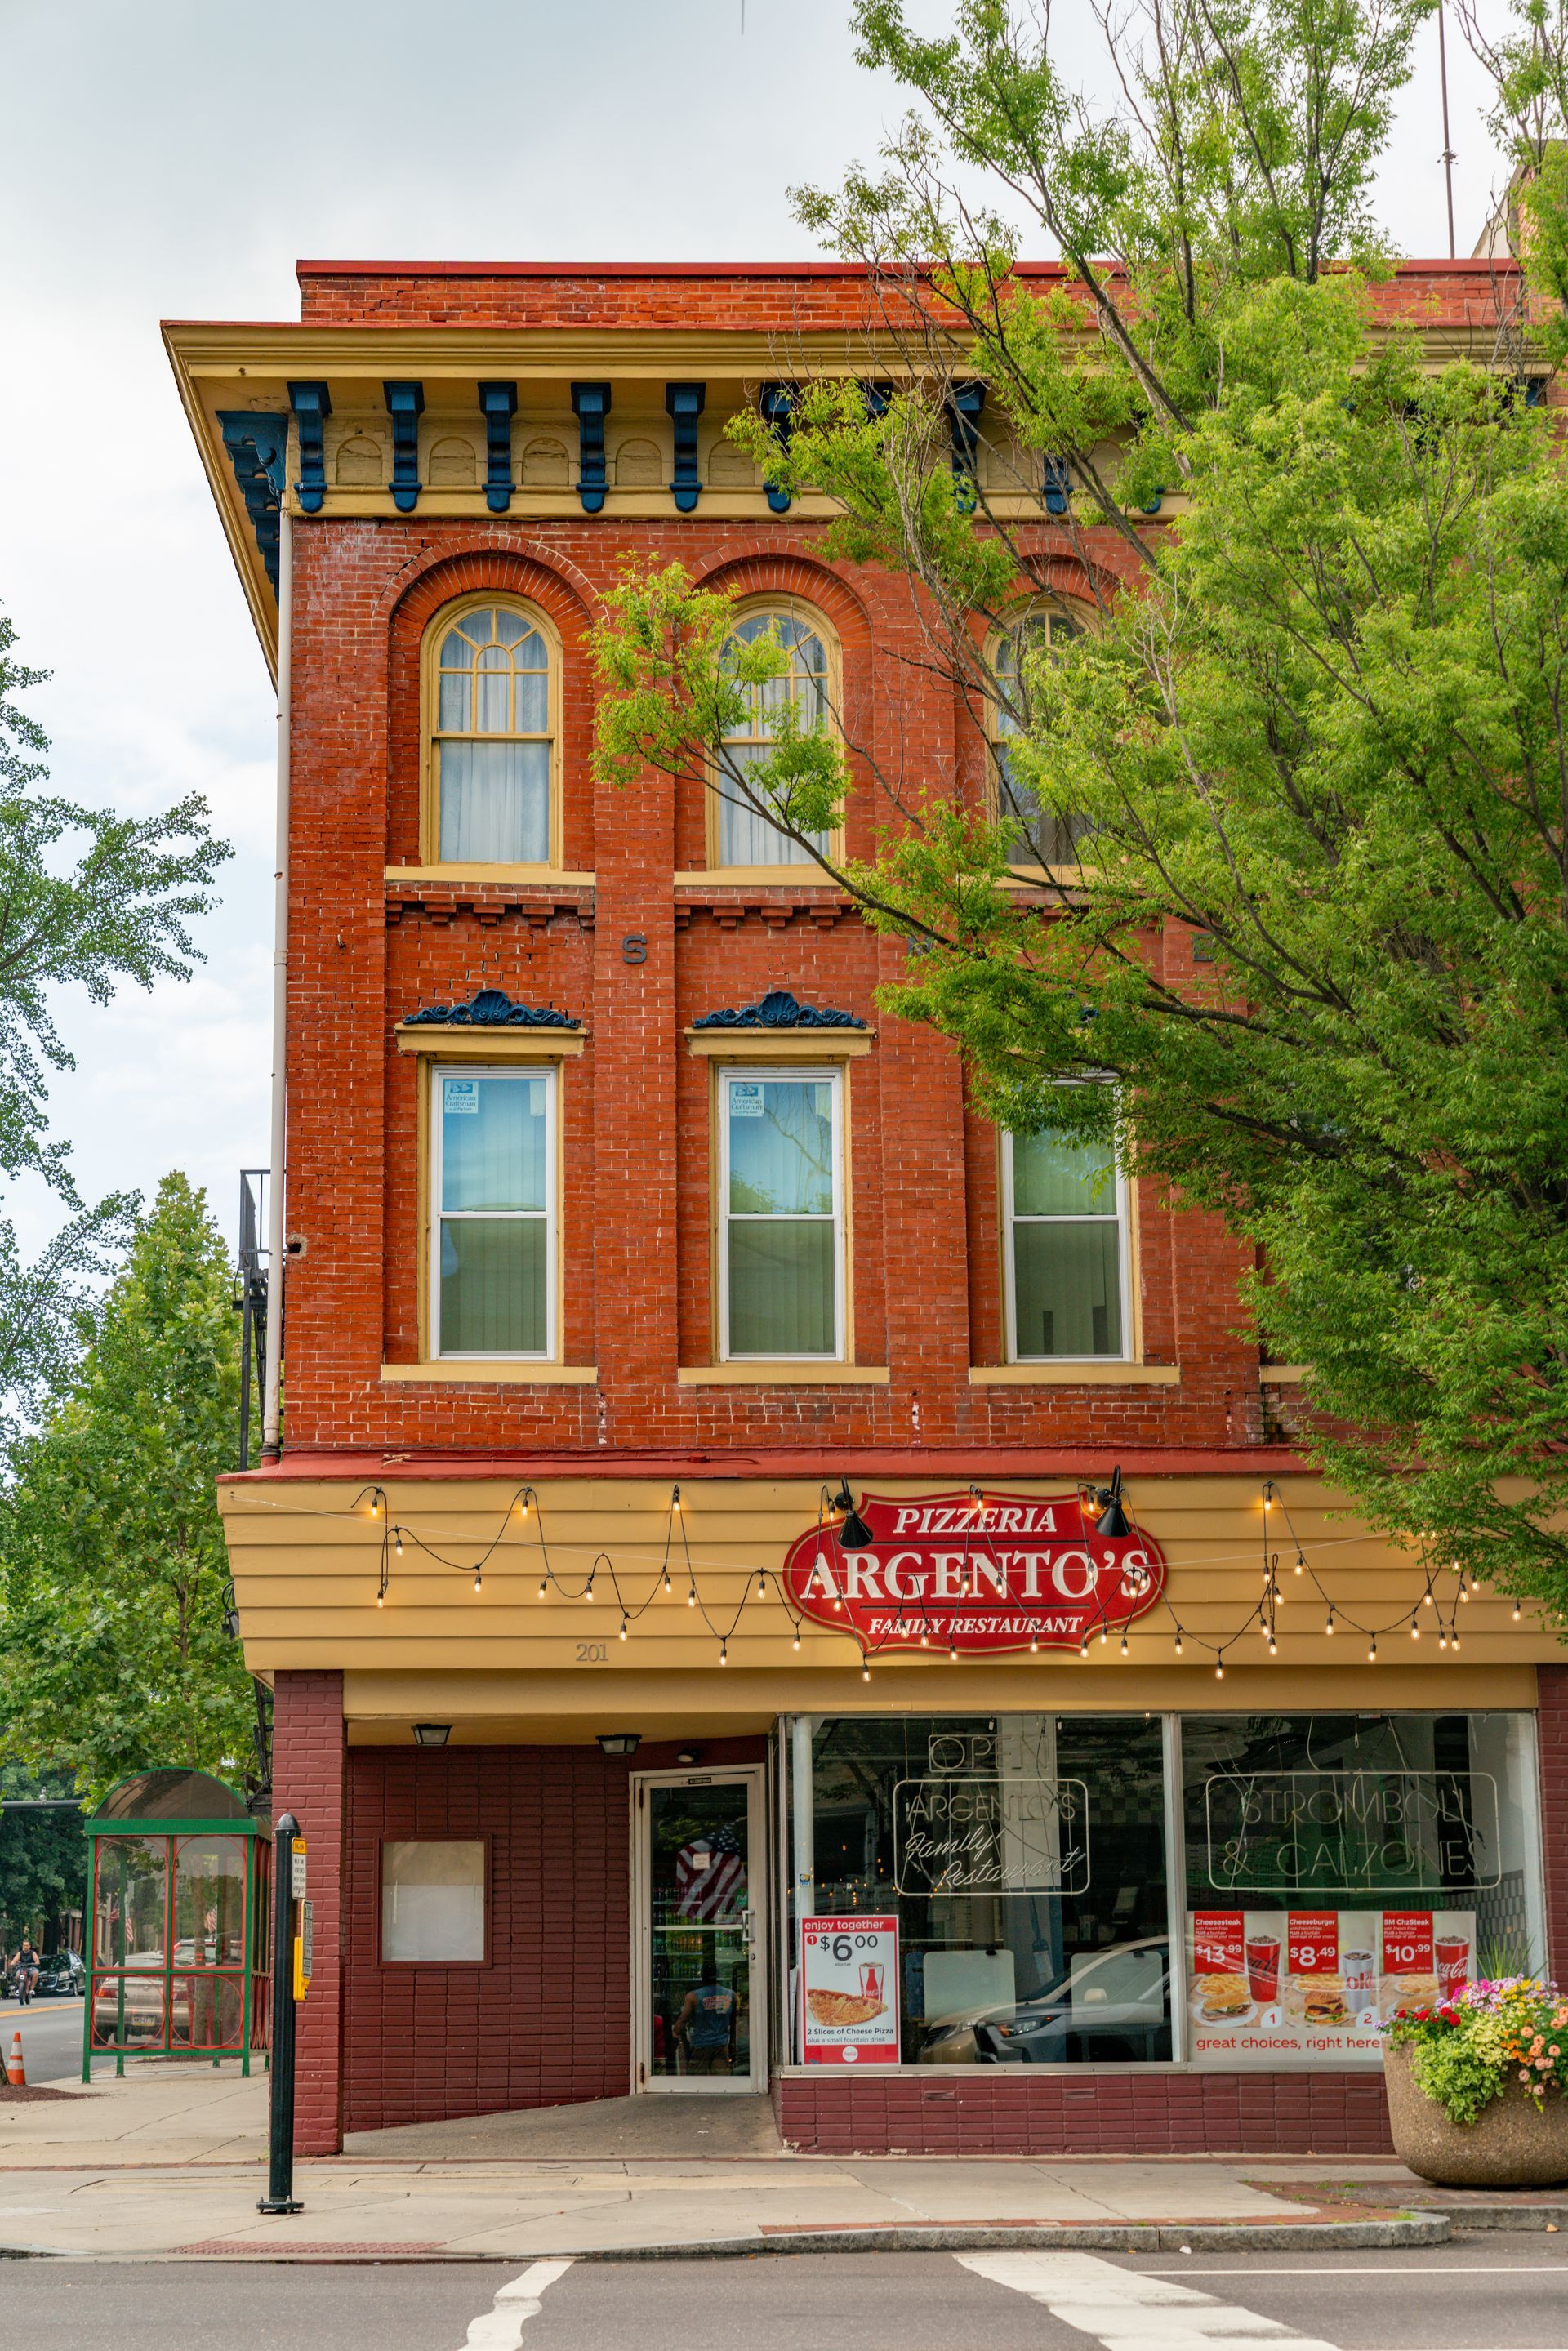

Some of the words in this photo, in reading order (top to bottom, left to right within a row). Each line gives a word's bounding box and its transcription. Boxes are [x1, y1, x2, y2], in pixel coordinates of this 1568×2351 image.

[622, 935, 647, 964] S
[893, 1507, 1057, 1534] PIZZERIA
[800, 1549, 1150, 1600] ARGENTO'S
[868, 1618, 945, 1634] FAMILY
[949, 1616, 1083, 1633] RESTAURANT
[576, 1644, 608, 1662] 201
[932, 1737, 1049, 1770] OPEN
[907, 1794, 1076, 1821] ARGENTO'S
[1242, 1788, 1463, 1824] STROMBOLI
[905, 1824, 1007, 1861] Family
[937, 1846, 1080, 1889] Restaurant
[1223, 1840, 1253, 1876] &
[1276, 1840, 1487, 1877] CALZONES
[804, 1921, 834, 1931] enjoy
[837, 1920, 884, 1930] together
[1196, 1944, 1241, 1962] $13.99
[1290, 1946, 1336, 1966] $8.49
[1385, 1944, 1430, 1962] $10.99
[1270, 2013, 1276, 2024] 1
[1364, 2013, 1372, 2024] 2
[1196, 2037, 1236, 2051] great
[1241, 2037, 1302, 2050] choices,
[1307, 2036, 1342, 2051] right
